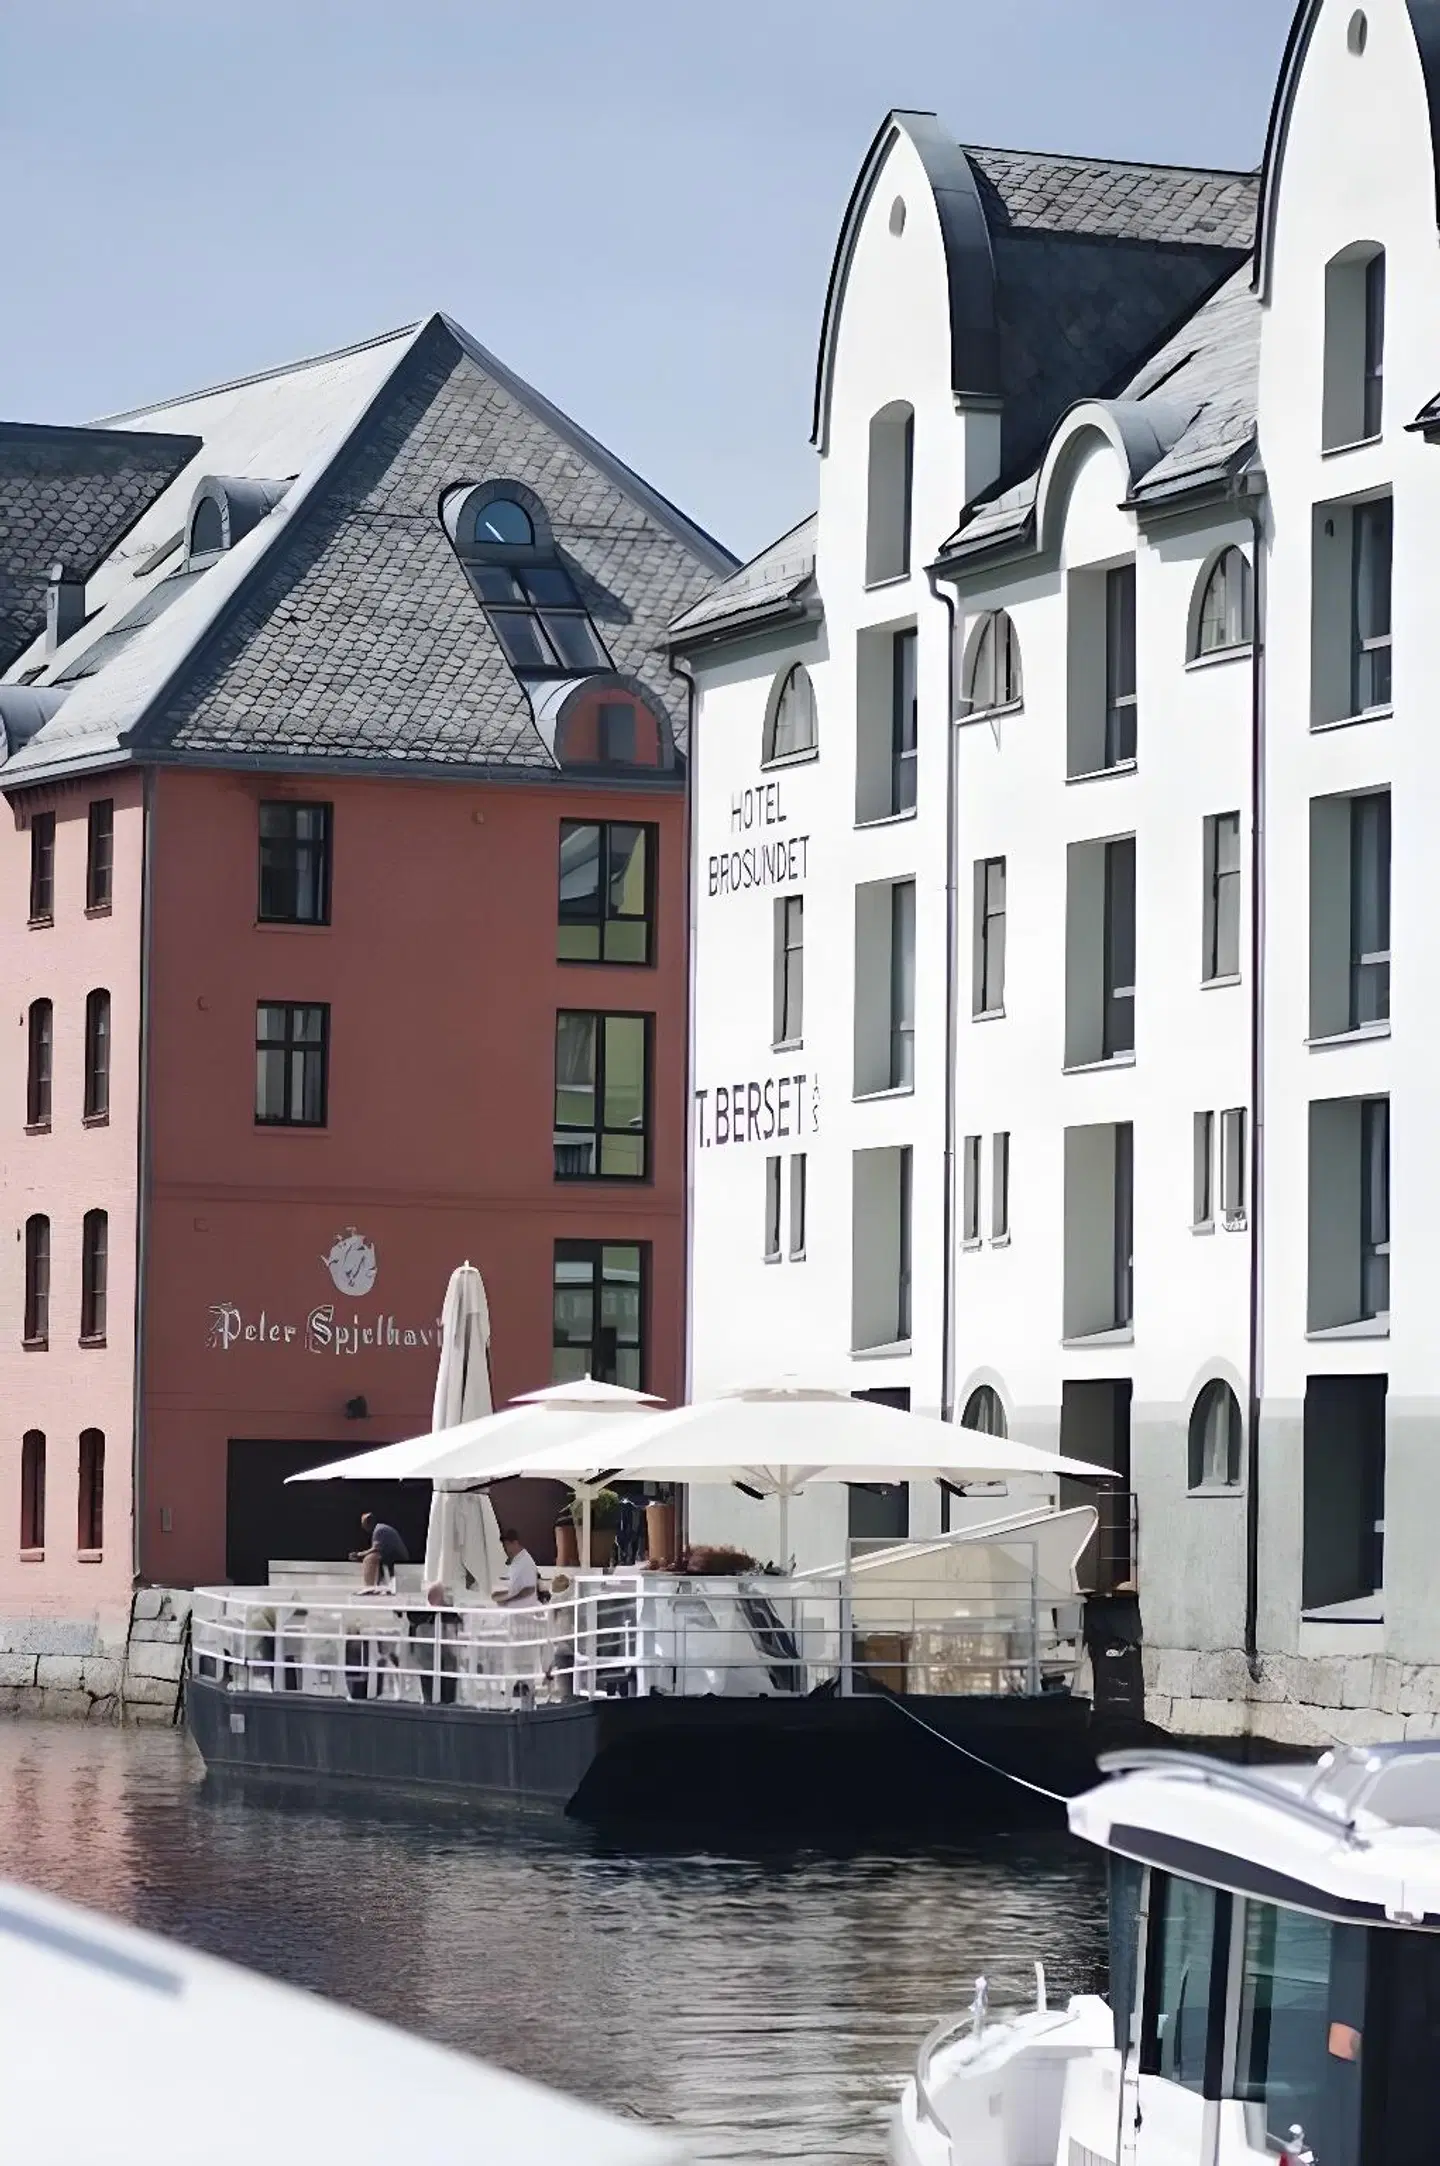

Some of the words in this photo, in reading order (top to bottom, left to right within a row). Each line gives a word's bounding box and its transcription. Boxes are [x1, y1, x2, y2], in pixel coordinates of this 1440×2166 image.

[731, 781, 787, 832] HOTEL
[708, 834, 810, 896] BROSUNDET
[716, 1074, 806, 1144] BERSET
